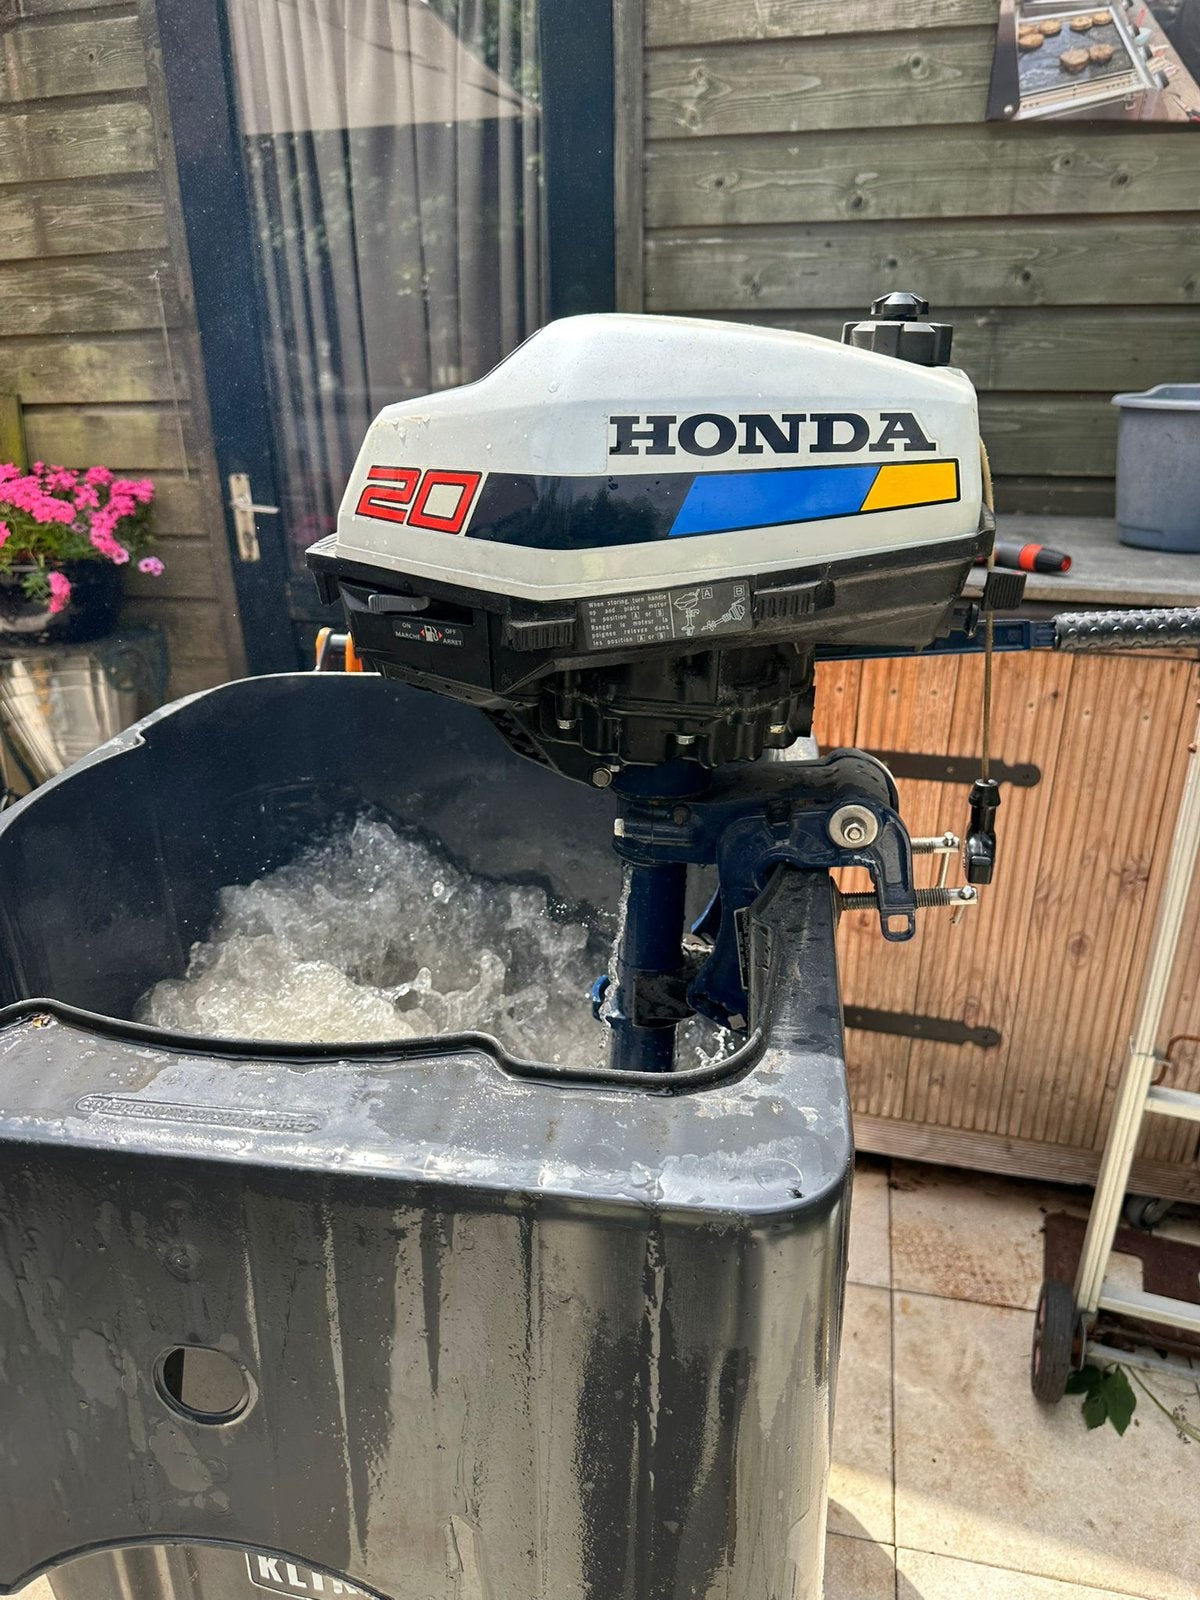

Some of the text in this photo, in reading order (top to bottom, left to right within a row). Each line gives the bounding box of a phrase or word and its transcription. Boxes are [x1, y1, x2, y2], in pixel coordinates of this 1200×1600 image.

[609, 413, 936, 456] HONDA
[355, 465, 482, 534] 20
[395, 631, 420, 640] MARCHE
